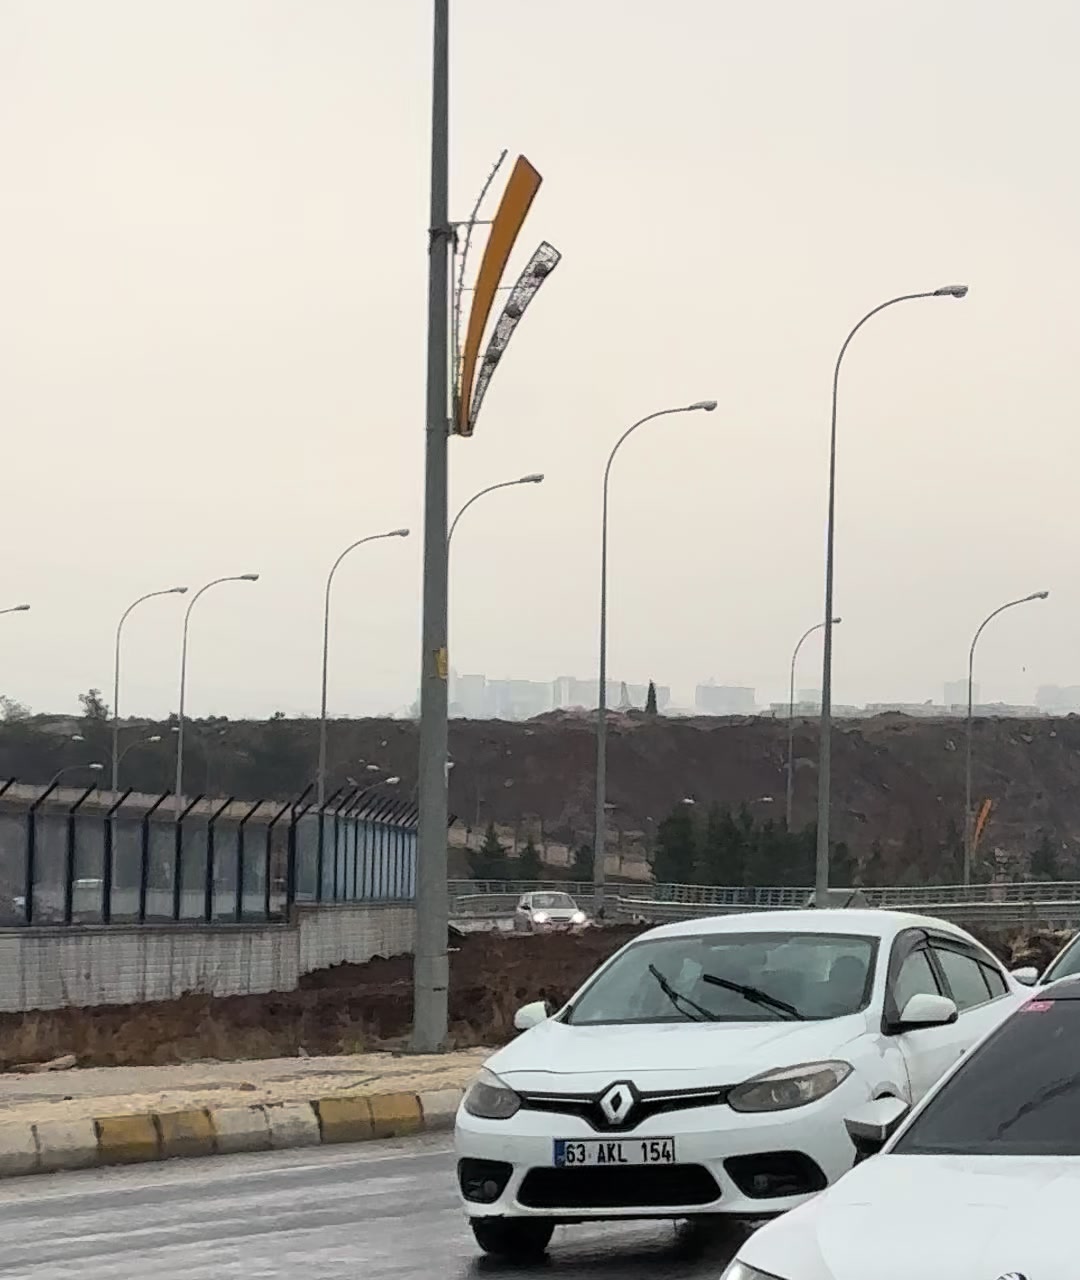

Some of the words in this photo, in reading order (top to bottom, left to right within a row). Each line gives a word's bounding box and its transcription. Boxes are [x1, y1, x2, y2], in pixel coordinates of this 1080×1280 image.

[566, 1143, 586, 1163] 63
[597, 1143, 628, 1163] AKL
[641, 1141, 671, 1163] 154
